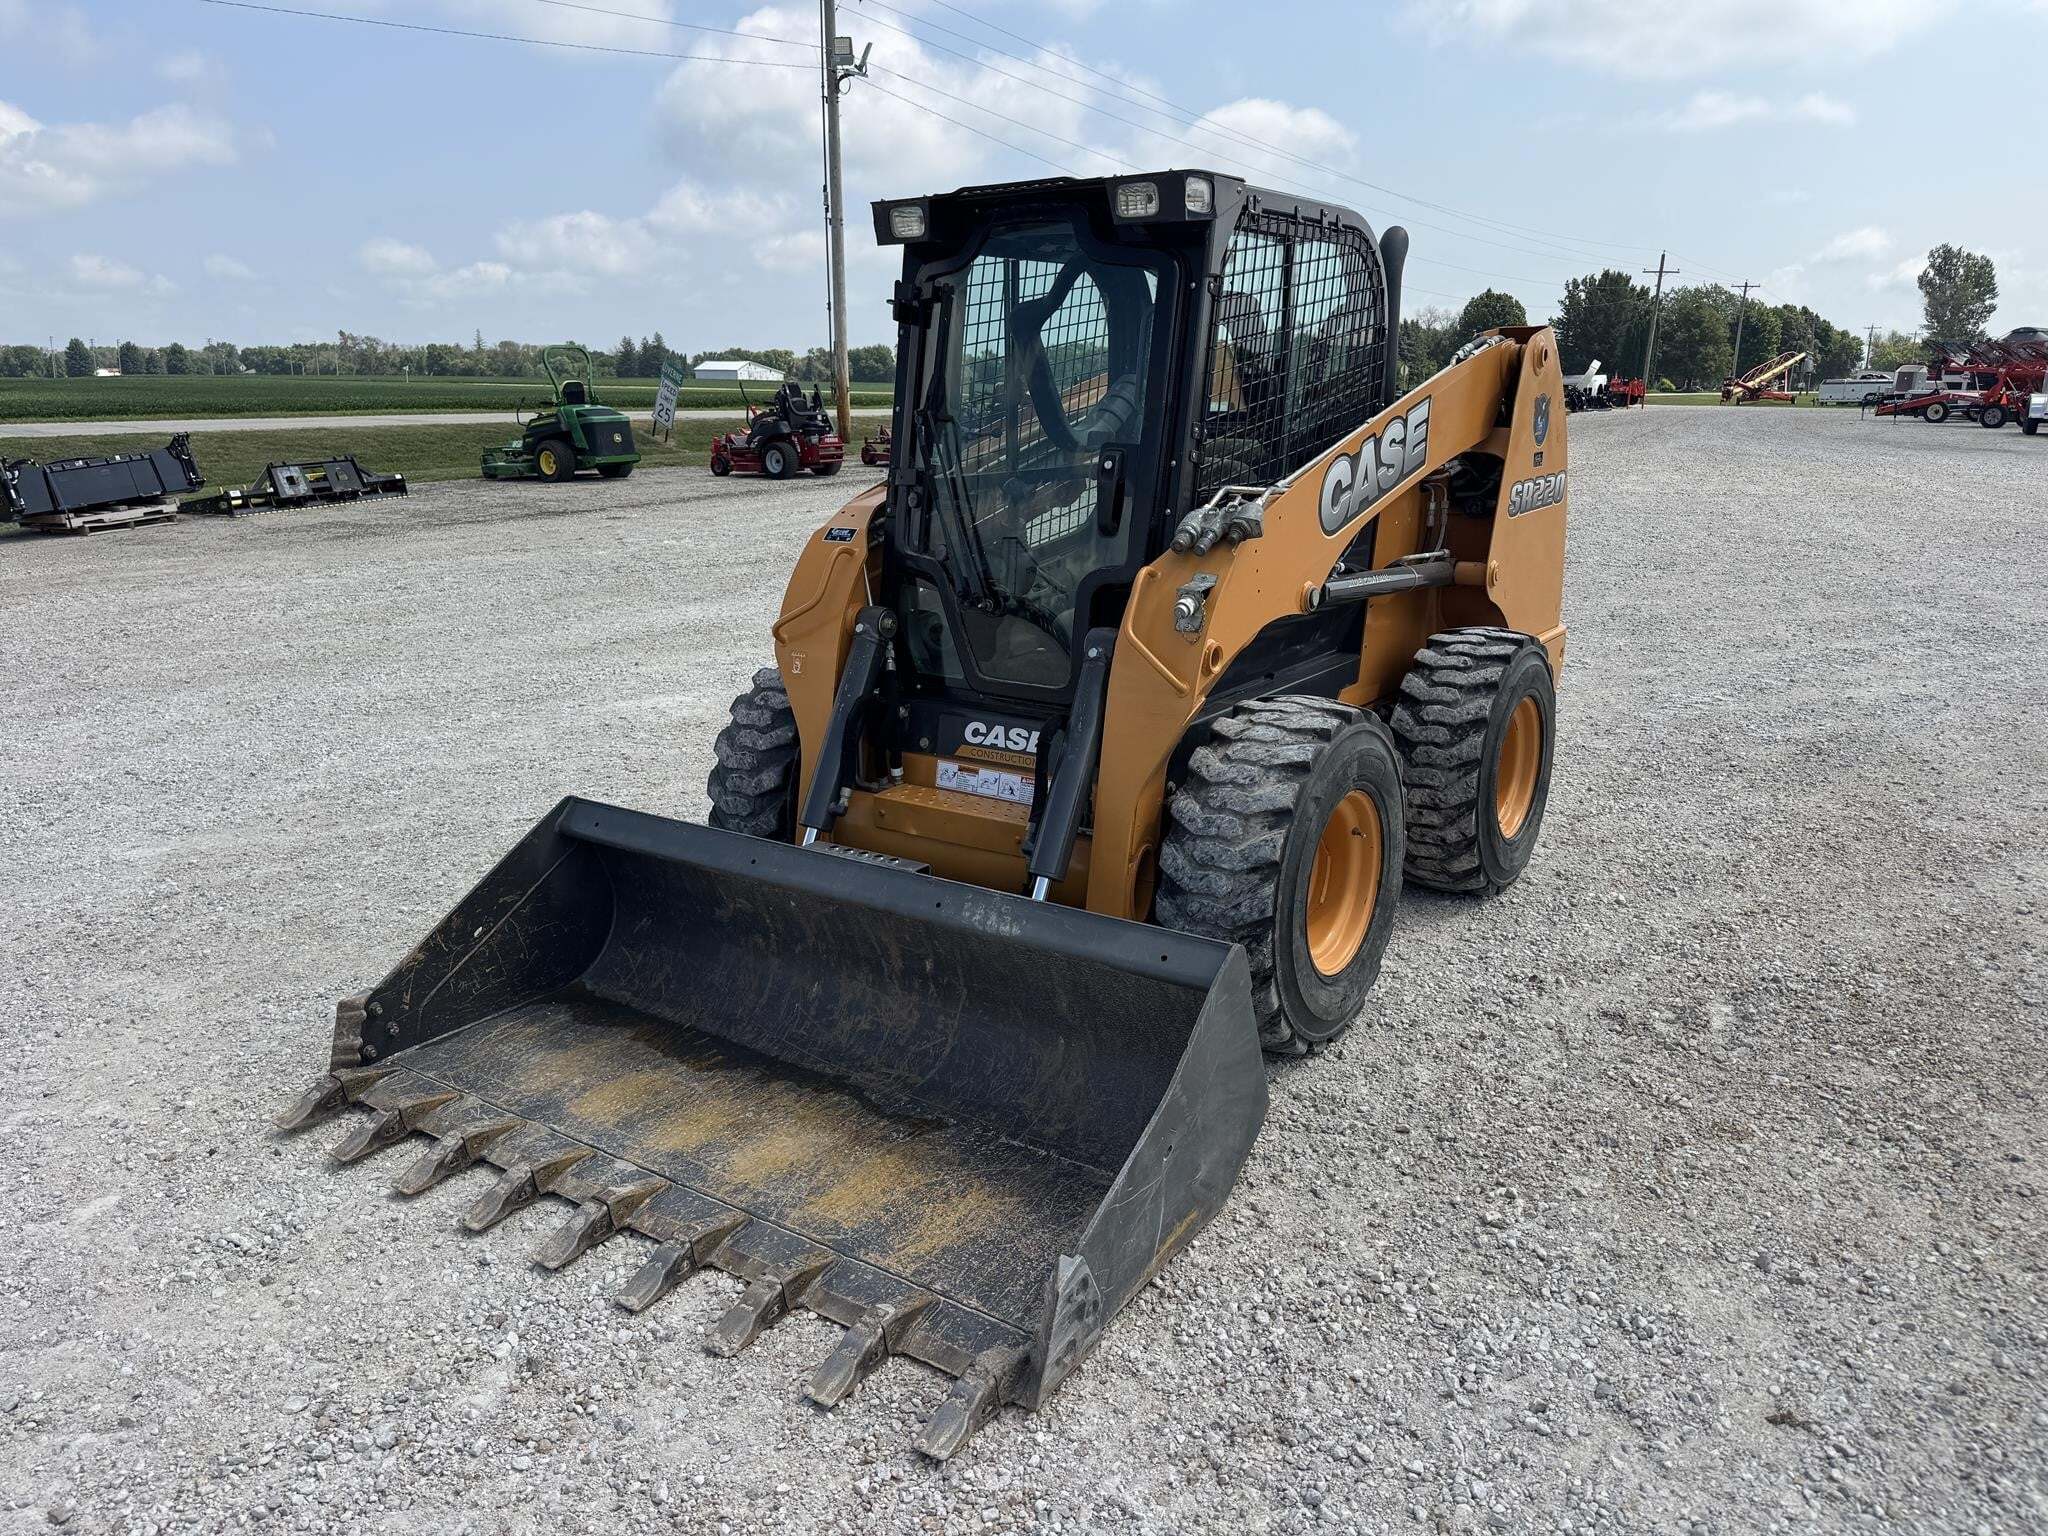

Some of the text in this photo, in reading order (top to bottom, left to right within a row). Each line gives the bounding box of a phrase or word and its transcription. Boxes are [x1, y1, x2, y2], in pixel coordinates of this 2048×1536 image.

[657, 403, 671, 423] 25
[1320, 398, 1430, 533] CASE
[1508, 470, 1566, 517] SR220
